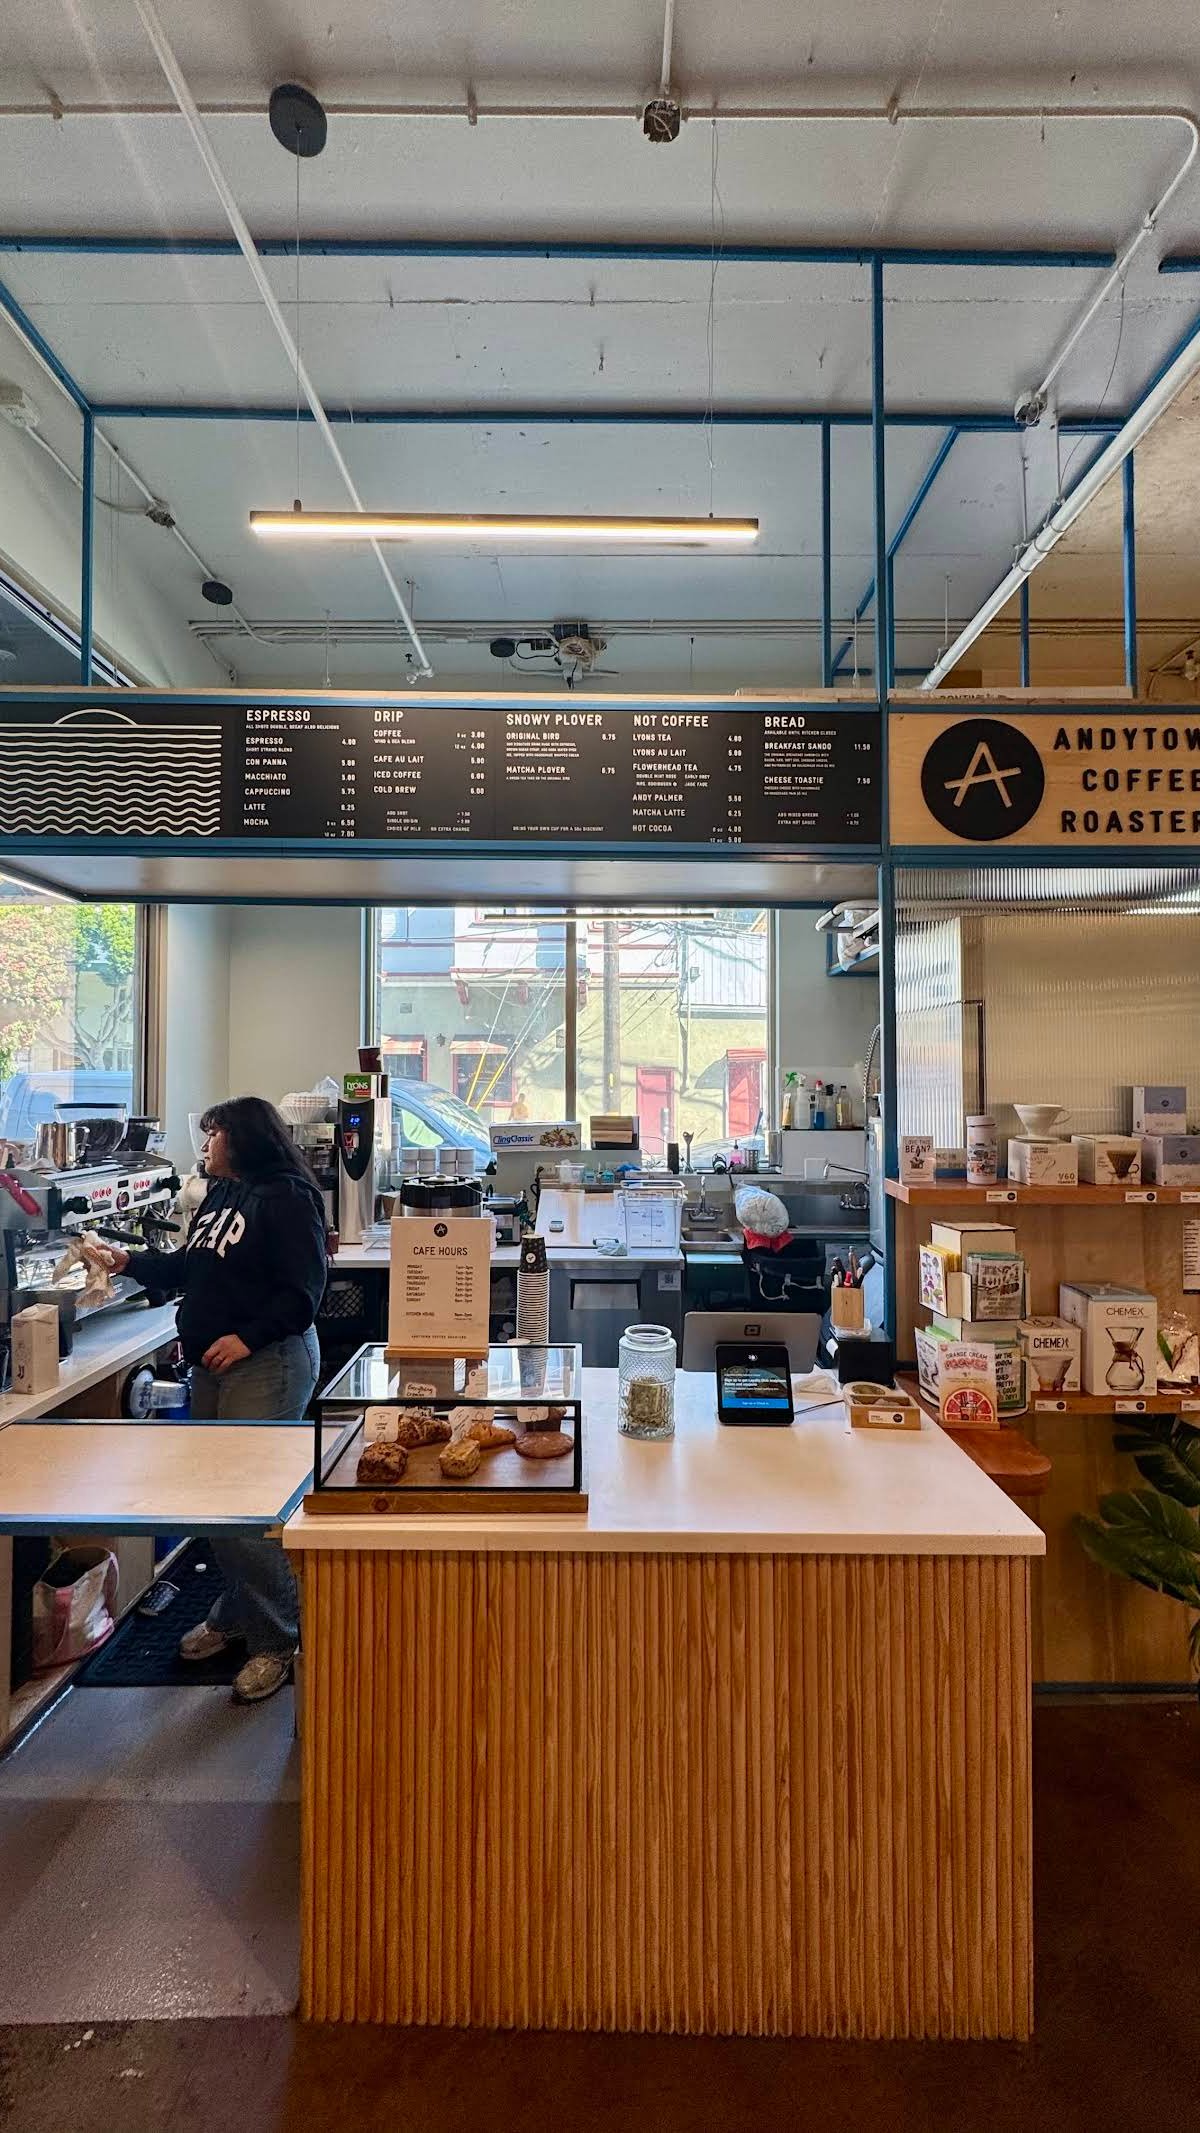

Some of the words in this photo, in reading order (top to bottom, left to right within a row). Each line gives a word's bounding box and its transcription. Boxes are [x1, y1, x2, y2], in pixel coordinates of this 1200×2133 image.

[246, 710, 311, 721] ESPRESSO
[374, 711, 404, 722] DRIP
[506, 714, 550, 726] SNOWY
[555, 714, 602, 726] PLOVER
[633, 715, 657, 727] NOT
[662, 715, 709, 727] COFFEE
[764, 716, 805, 728] BREAD
[1053, 728, 1200, 750] ANDYTOW
[470, 742, 485, 750] 4.00
[764, 742, 806, 750] BREAKFAST
[808, 742, 832, 750] SANDO
[670, 749, 686, 757] LAIT
[373, 755, 392, 763] CAFE
[538, 766, 565, 774] PLOVER
[632, 763, 681, 771] FLOWERHEAD
[373, 771, 391, 779] ICED
[393, 771, 421, 779] COFFEE
[764, 776, 792, 784] CHEESE
[1082, 769, 1200, 791] COFFEE
[395, 786, 416, 794] BREW
[664, 809, 686, 817] LATTE
[243, 818, 269, 826] MOCHA
[346, 1082, 368, 1091] LYONS
[905, 1145, 930, 1153] BEAN?
[413, 1246, 436, 1256] CAFE
[439, 1247, 468, 1256] HOURS
[1106, 1307, 1144, 1316] CHEMEX
[1034, 1337, 1069, 1348] CHEMEX
